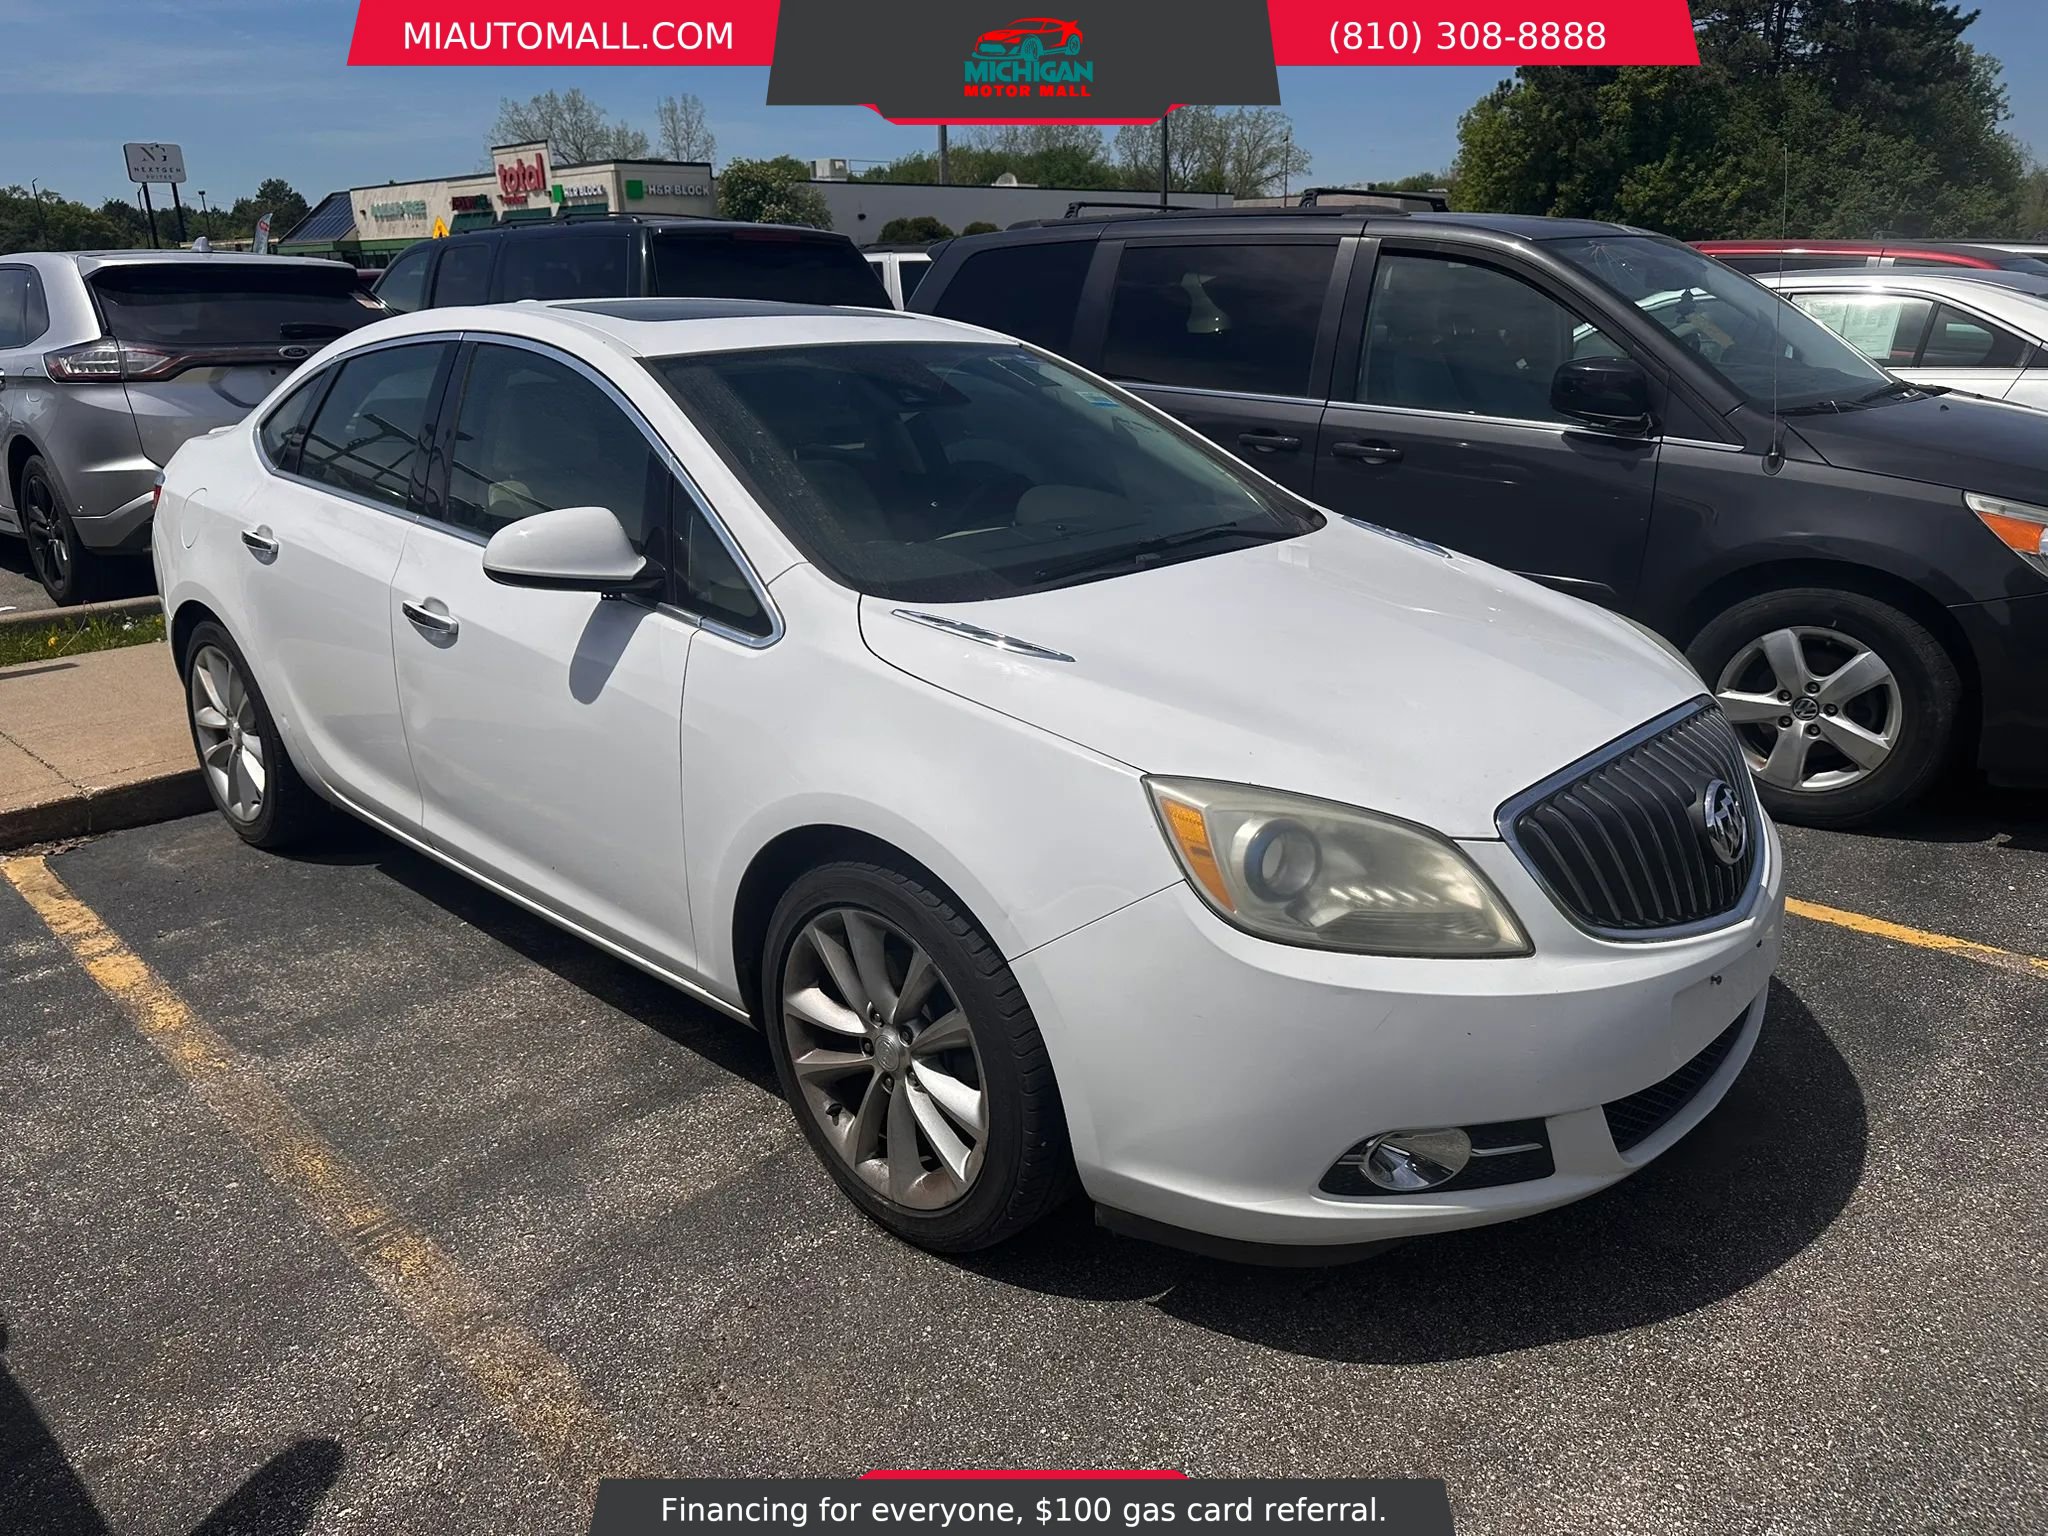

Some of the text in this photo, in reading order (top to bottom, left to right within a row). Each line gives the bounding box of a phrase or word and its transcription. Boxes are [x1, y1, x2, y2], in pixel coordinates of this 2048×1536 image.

[498, 152, 547, 192] total
[579, 184, 604, 196] BLOCK
[648, 184, 710, 196] H&R BLOCK
